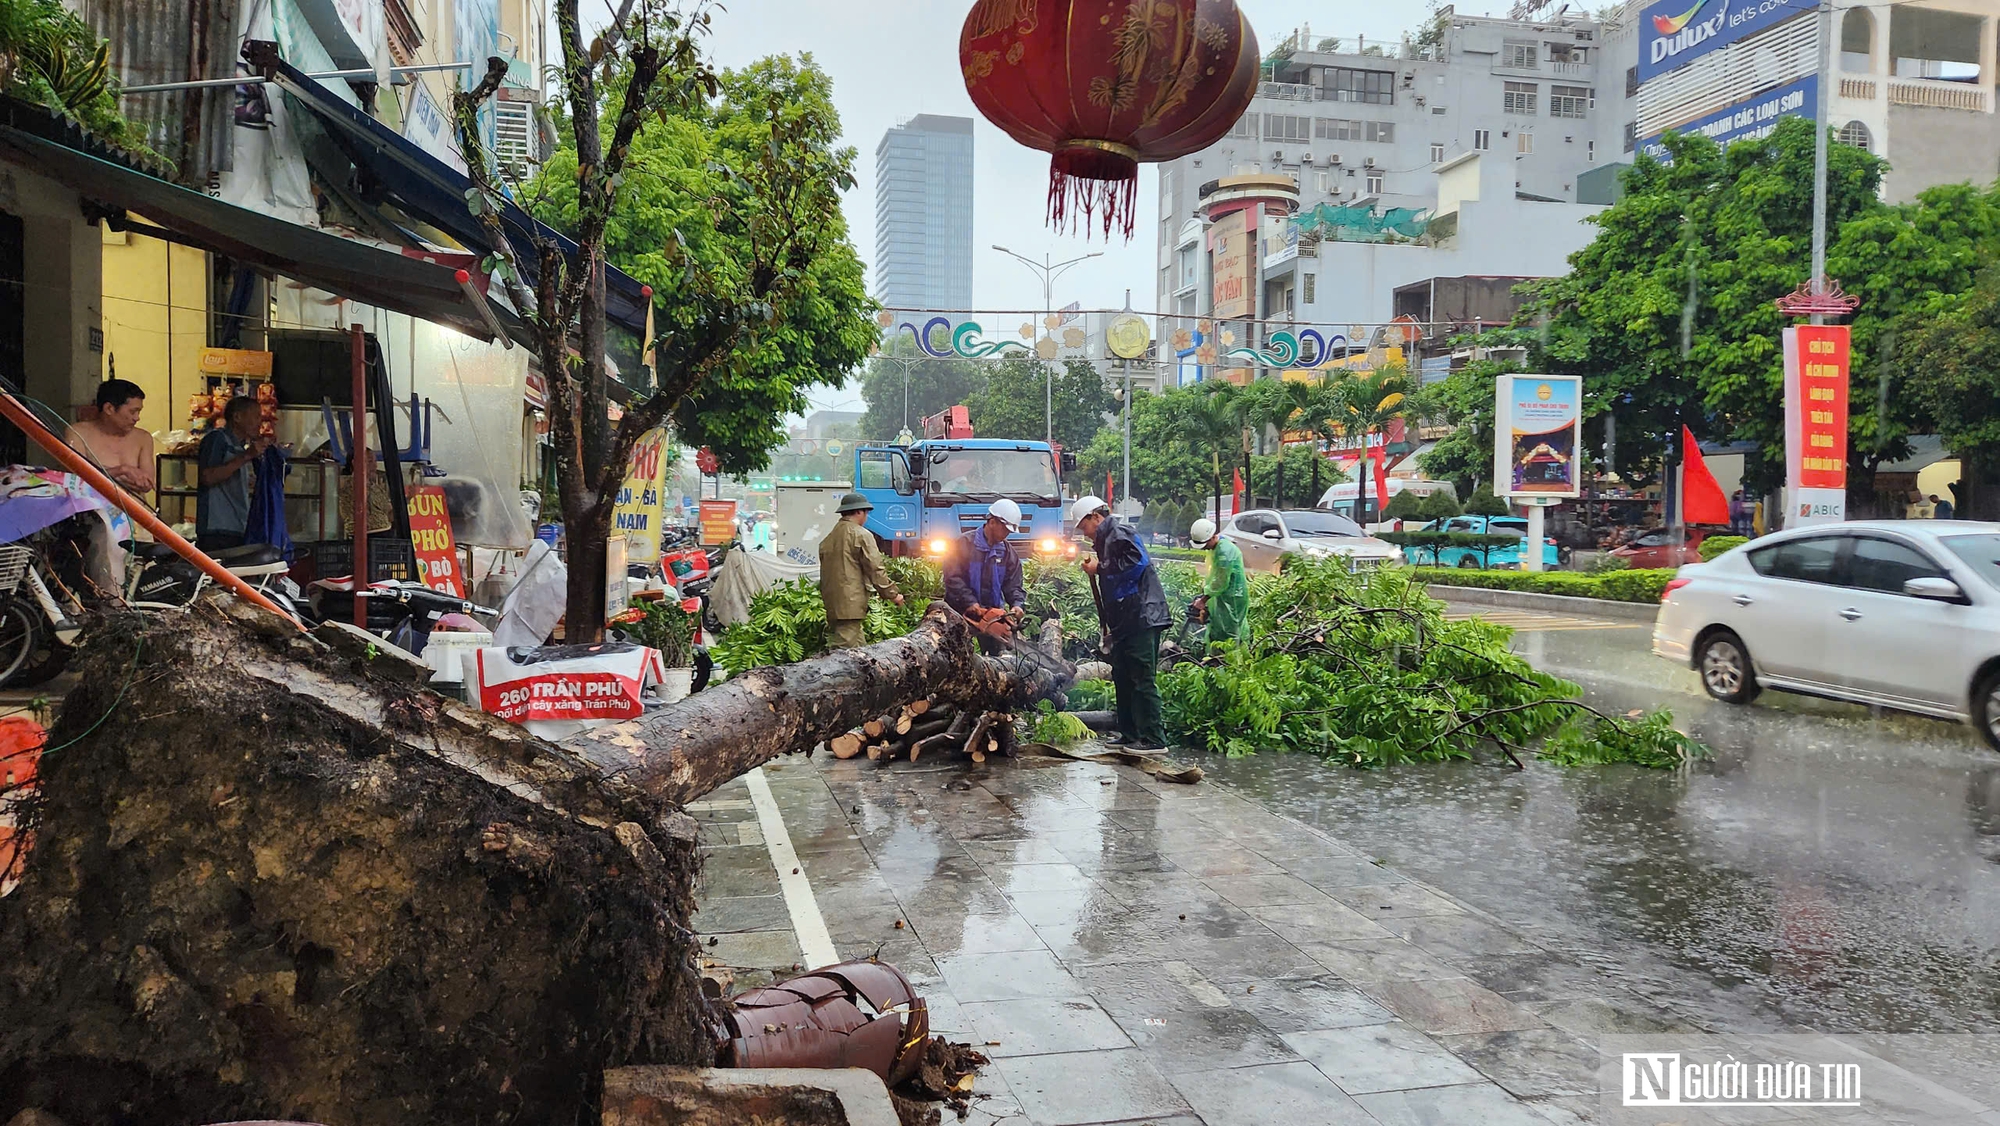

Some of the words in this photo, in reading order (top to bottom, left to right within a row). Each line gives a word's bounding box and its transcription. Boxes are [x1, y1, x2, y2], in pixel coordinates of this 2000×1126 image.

[1729, 6, 1757, 28] let's
[1759, 0, 1789, 14] co
[1651, 16, 1718, 65] Dulux
[1734, 107, 1754, 129] CÁC
[1756, 99, 1779, 120] LOẠI
[1781, 90, 1804, 112] SƠN
[628, 432, 662, 481] HỞ
[407, 487, 445, 516] BÚN
[1813, 505, 1840, 516] ABIC
[411, 519, 450, 552] PHỞ
[616, 513, 648, 531] NAM
[430, 556, 453, 578] BÒ
[140, 578, 167, 593] YAMAHA
[499, 686, 531, 707] 260
[532, 677, 582, 698] TRẦN
[586, 677, 623, 697] PHÚ
[532, 700, 553, 712] cây
[554, 700, 582, 711] xăng
[608, 698, 631, 710] Phú)
